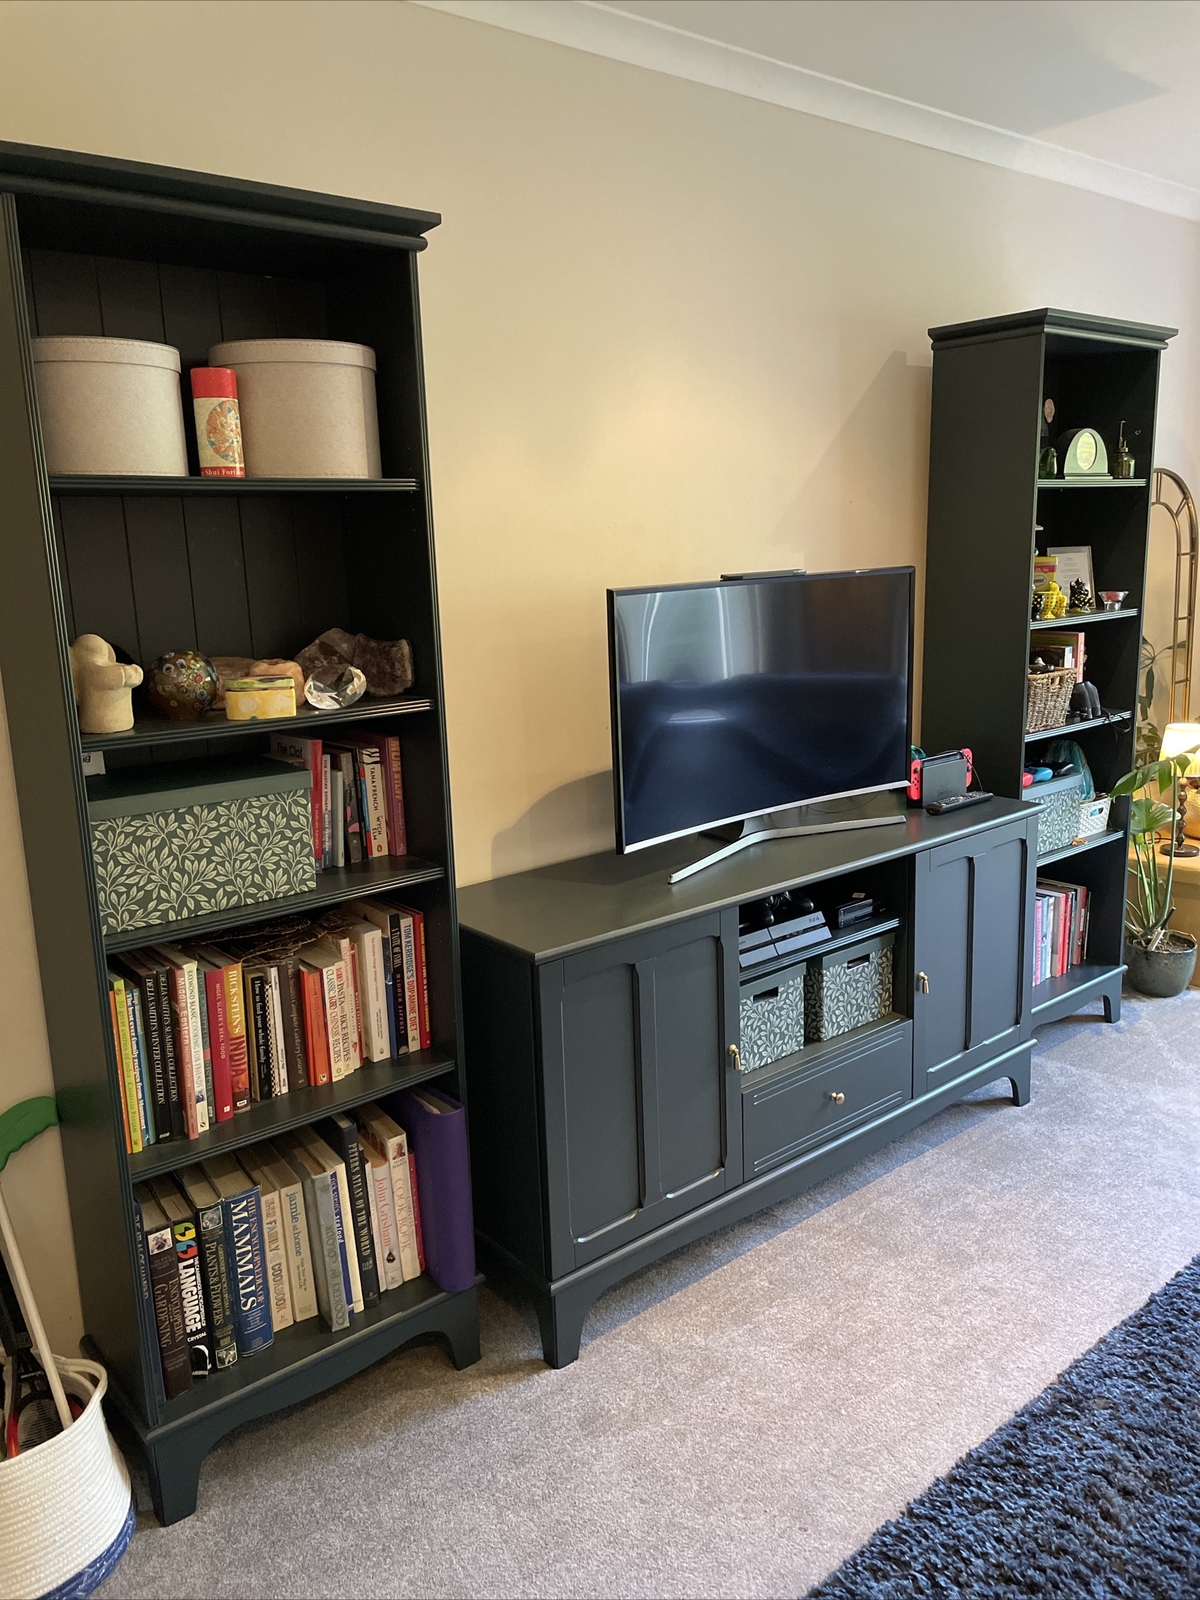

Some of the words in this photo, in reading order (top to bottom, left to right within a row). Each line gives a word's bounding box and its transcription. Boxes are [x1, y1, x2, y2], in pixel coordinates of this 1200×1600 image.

[204, 468, 220, 476] Shui
[390, 740, 400, 773] MUM
[371, 784, 379, 811] FRENCH
[404, 923, 412, 940] TOM
[404, 940, 414, 980] KERRIDGE'S
[146, 978, 155, 1001] DELIA
[160, 974, 169, 996] DELIA
[177, 977, 187, 1009] Middle
[187, 970, 195, 1000] RAYMOND
[229, 970, 238, 995] RICK
[326, 968, 337, 995] CLASSIC
[337, 982, 346, 1006] PASTA
[118, 1000, 124, 1009] 50
[162, 996, 171, 1026] SMITH'S
[189, 1000, 198, 1020] BLANC
[255, 995, 261, 1003] to
[255, 1002, 263, 1014] feed
[329, 995, 338, 1010] 1000
[407, 980, 417, 1016] DOPAMINE
[118, 1011, 126, 1028] great
[148, 1001, 158, 1031] SMITH'S
[180, 1010, 190, 1045] Eastern
[231, 996, 241, 1034] STEIN'S
[290, 999, 298, 1028] Complete
[294, 1029, 302, 1054] Cookery
[330, 1011, 340, 1039] CHINESE
[340, 1013, 348, 1032] RICE
[410, 1016, 418, 1032] DIET
[131, 1036, 139, 1059] family
[151, 1031, 161, 1060] WINTER
[165, 1026, 174, 1058] SUMMER
[191, 1021, 200, 1050] COOKING
[342, 1032, 352, 1063] RECIPES
[193, 1050, 201, 1061] FOR
[229, 1034, 247, 1076] INDIA
[258, 1046, 266, 1064] family
[332, 1038, 342, 1064] RECIPES
[133, 1058, 141, 1084] recipes
[154, 1060, 165, 1105] COLLECTION
[168, 1058, 178, 1102] COLLECTION
[194, 1061, 203, 1089] FRIENDS
[348, 1142, 360, 1173] PETERS
[330, 1178, 338, 1190] rick
[352, 1174, 363, 1198] ATLAS
[375, 1177, 388, 1202] John
[394, 1178, 407, 1215] COOK
[248, 1195, 256, 1215] THE
[286, 1191, 301, 1224] jamie
[332, 1191, 340, 1212] stein's
[356, 1199, 364, 1209] OF
[406, 1196, 414, 1227] COMPLETE
[335, 1215, 344, 1243] seafood
[357, 1210, 367, 1227] THE
[380, 1203, 392, 1247] Grisham
[266, 1219, 280, 1252] FAMILY
[293, 1230, 302, 1257] home
[326, 1224, 337, 1264] COLOUR
[360, 1227, 371, 1256] WORLD
[398, 1218, 411, 1252] BOOK
[206, 1242, 219, 1278] PLANTS
[231, 1199, 257, 1310] MAMMALS
[250, 1216, 264, 1291] ENCYCLOPAEDIA
[330, 1268, 340, 1278] IN
[178, 1258, 202, 1333] LANGUAGE
[257, 1291, 265, 1302] OF
[271, 1262, 287, 1314] COOKBOOK
[154, 1283, 172, 1348] GARDENING
[168, 1277, 184, 1342] ENCYCLOPEDIA
[210, 1283, 224, 1326] FLOWERS
[333, 1283, 345, 1326] COOKERY
